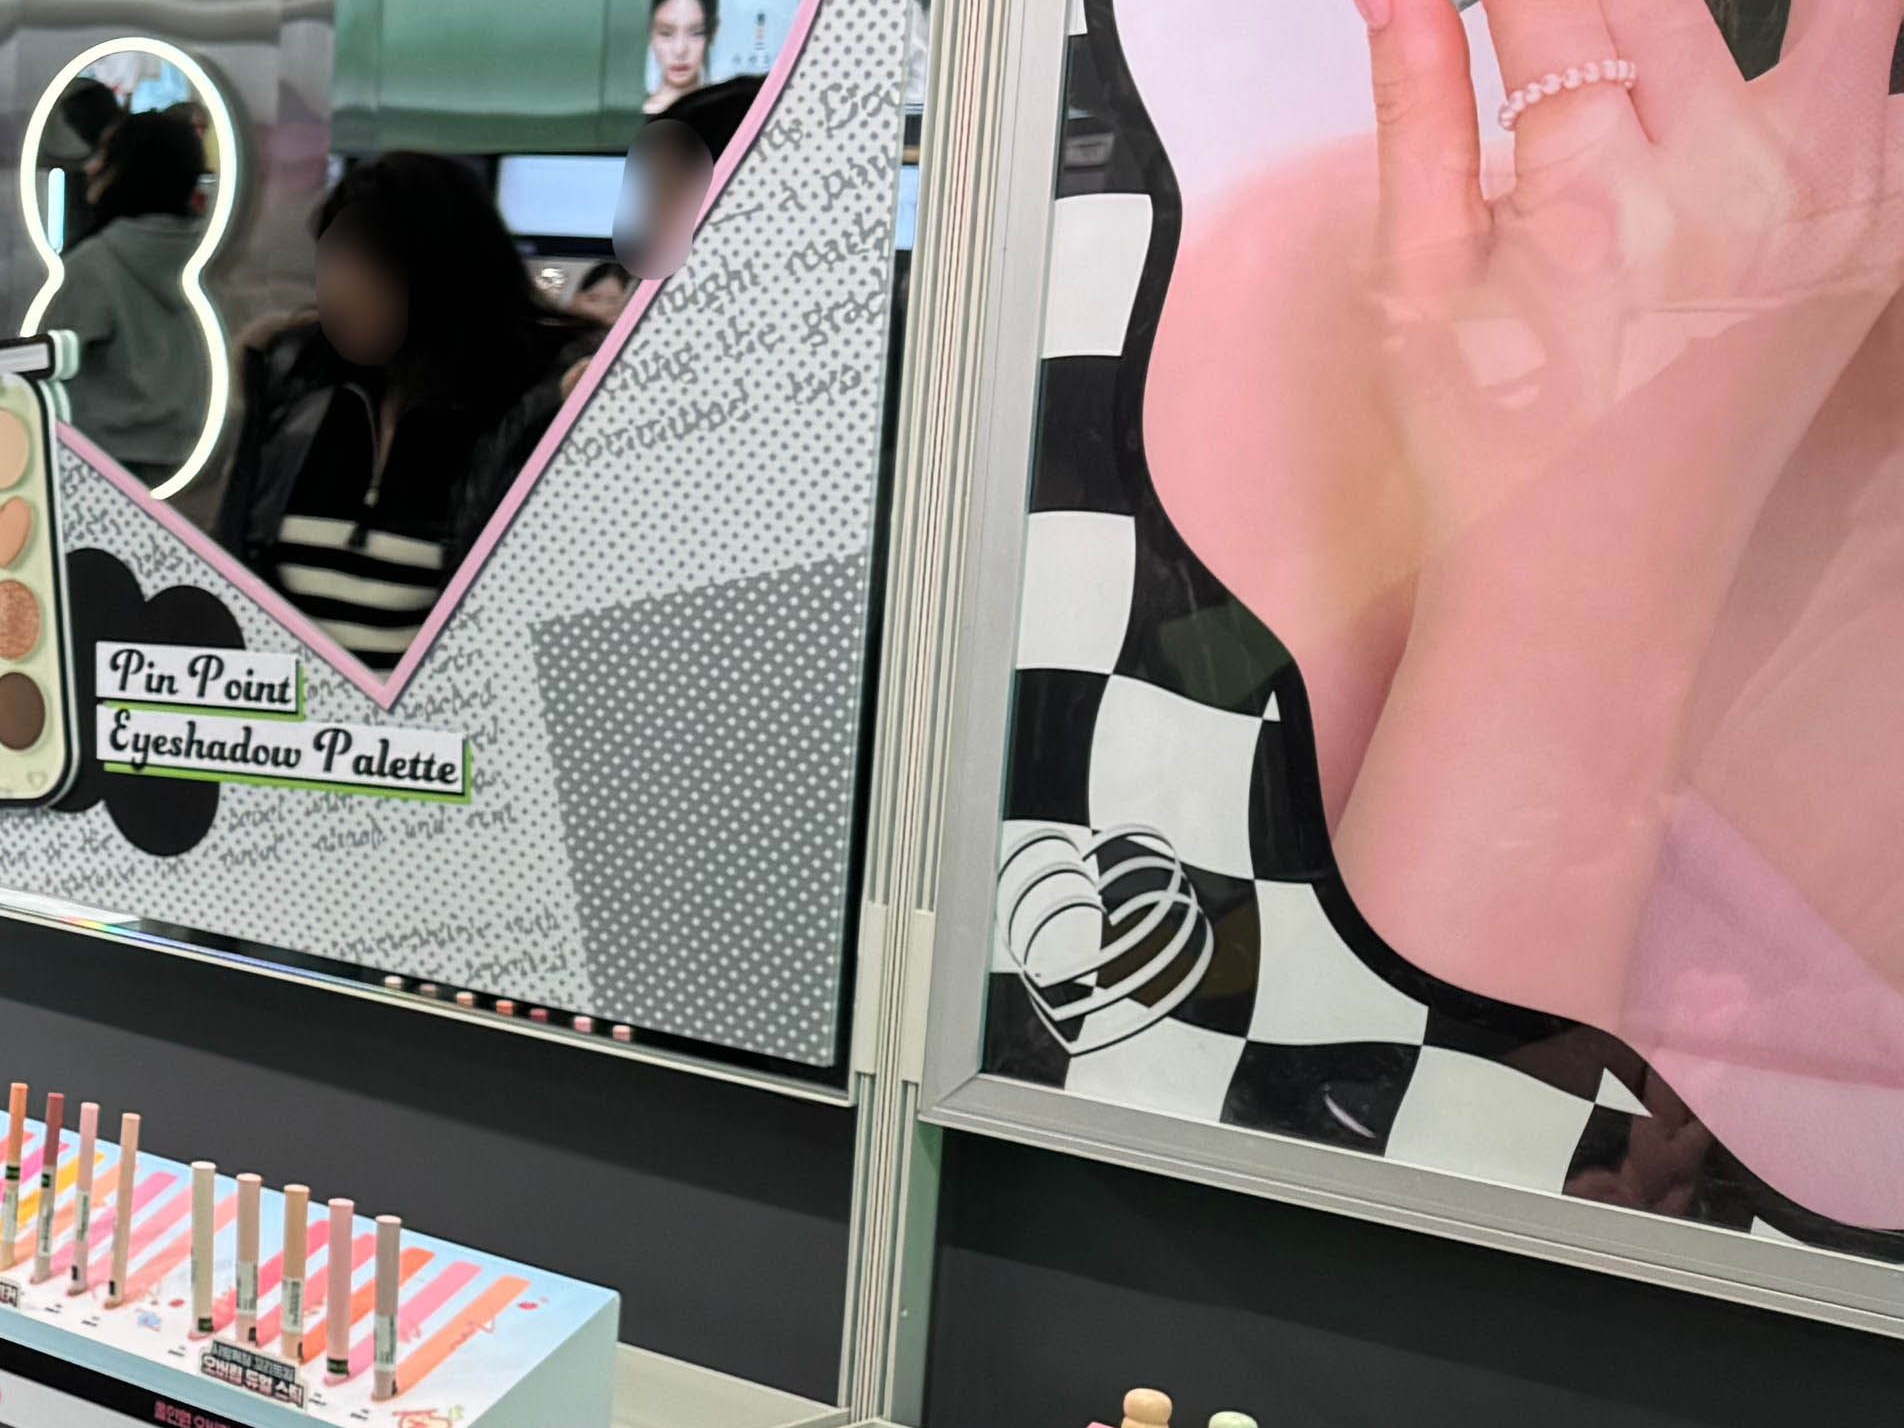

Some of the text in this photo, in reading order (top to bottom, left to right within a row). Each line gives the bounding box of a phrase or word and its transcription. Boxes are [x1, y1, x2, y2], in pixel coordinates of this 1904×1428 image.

[109, 646, 293, 710] Pin Point
[109, 708, 459, 789] Eyeshadow Palette
